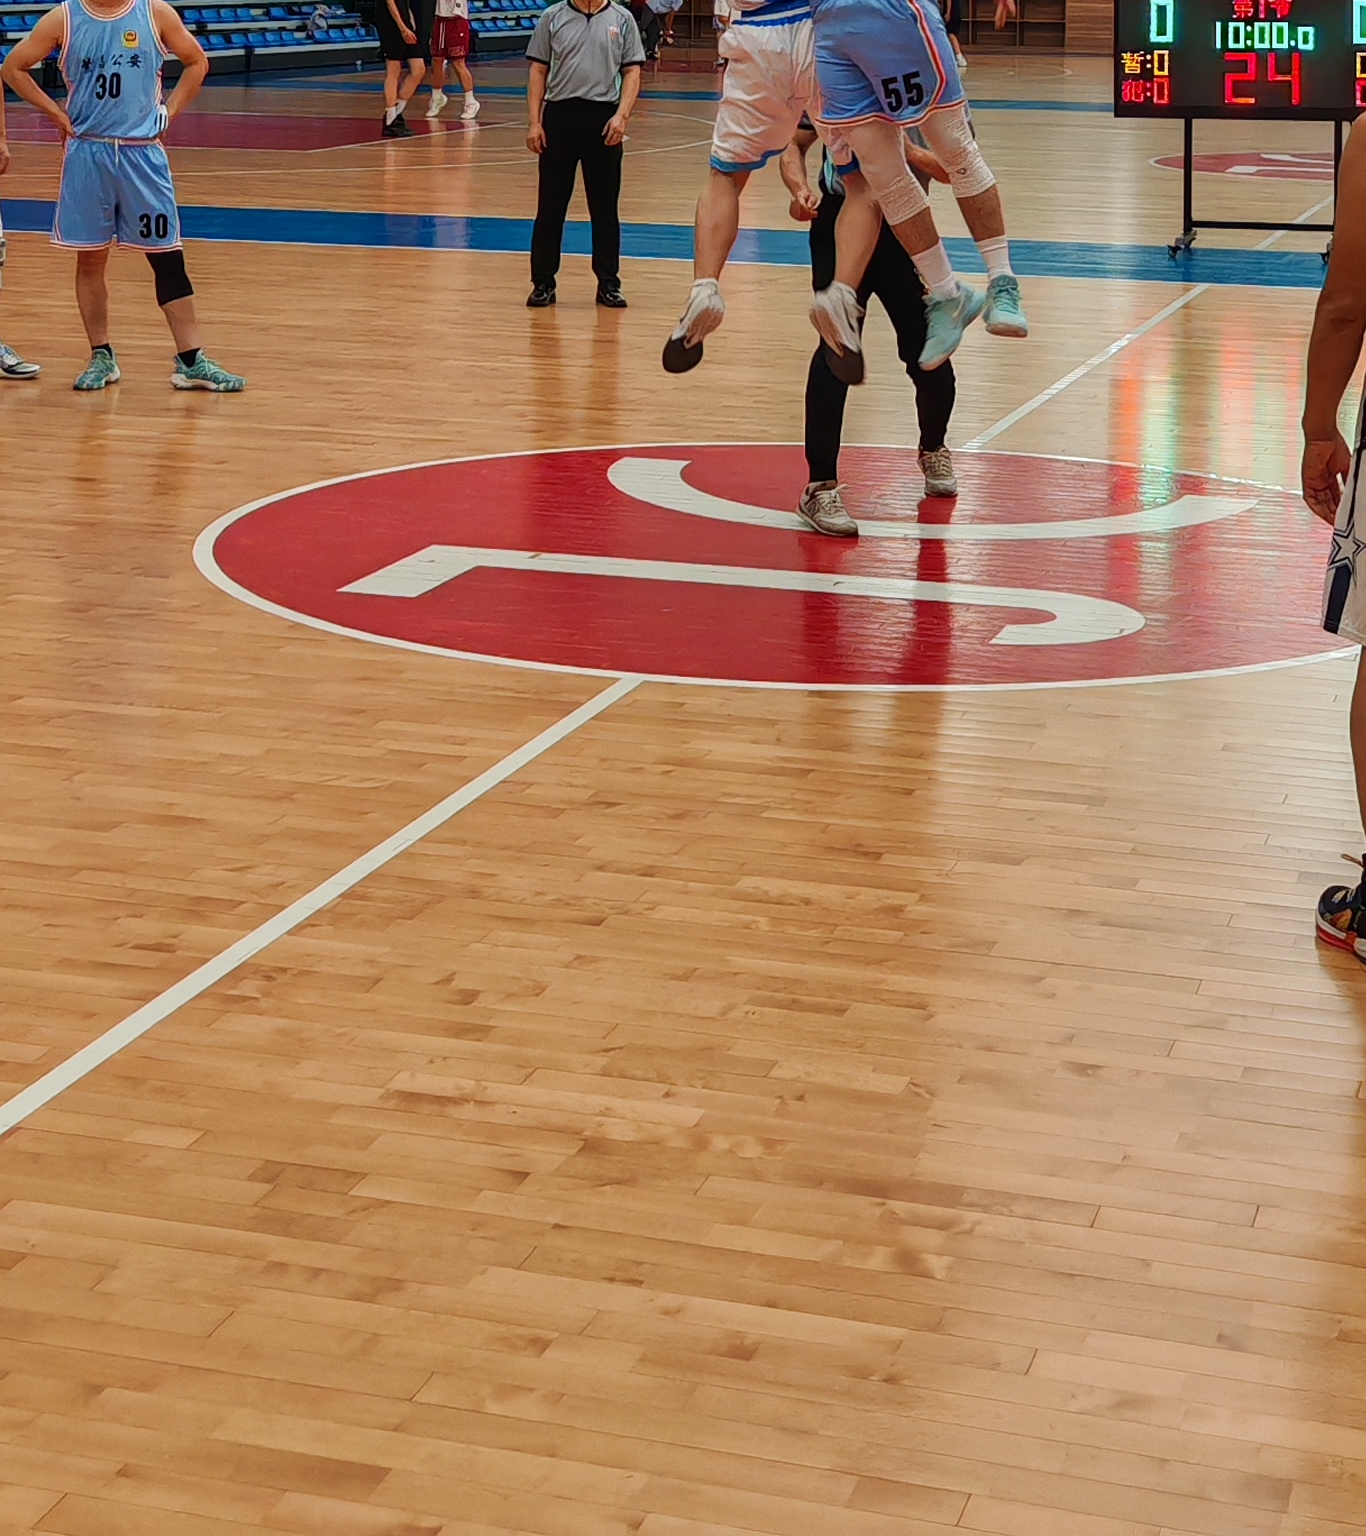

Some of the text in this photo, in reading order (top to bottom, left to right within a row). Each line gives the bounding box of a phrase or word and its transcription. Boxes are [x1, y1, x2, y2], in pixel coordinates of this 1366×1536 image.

[1215, 21, 1315, 50] 10:00.0
[95, 72, 121, 100] 30
[880, 70, 924, 114] 55
[1223, 52, 1302, 106] 24
[138, 213, 168, 239] 30
